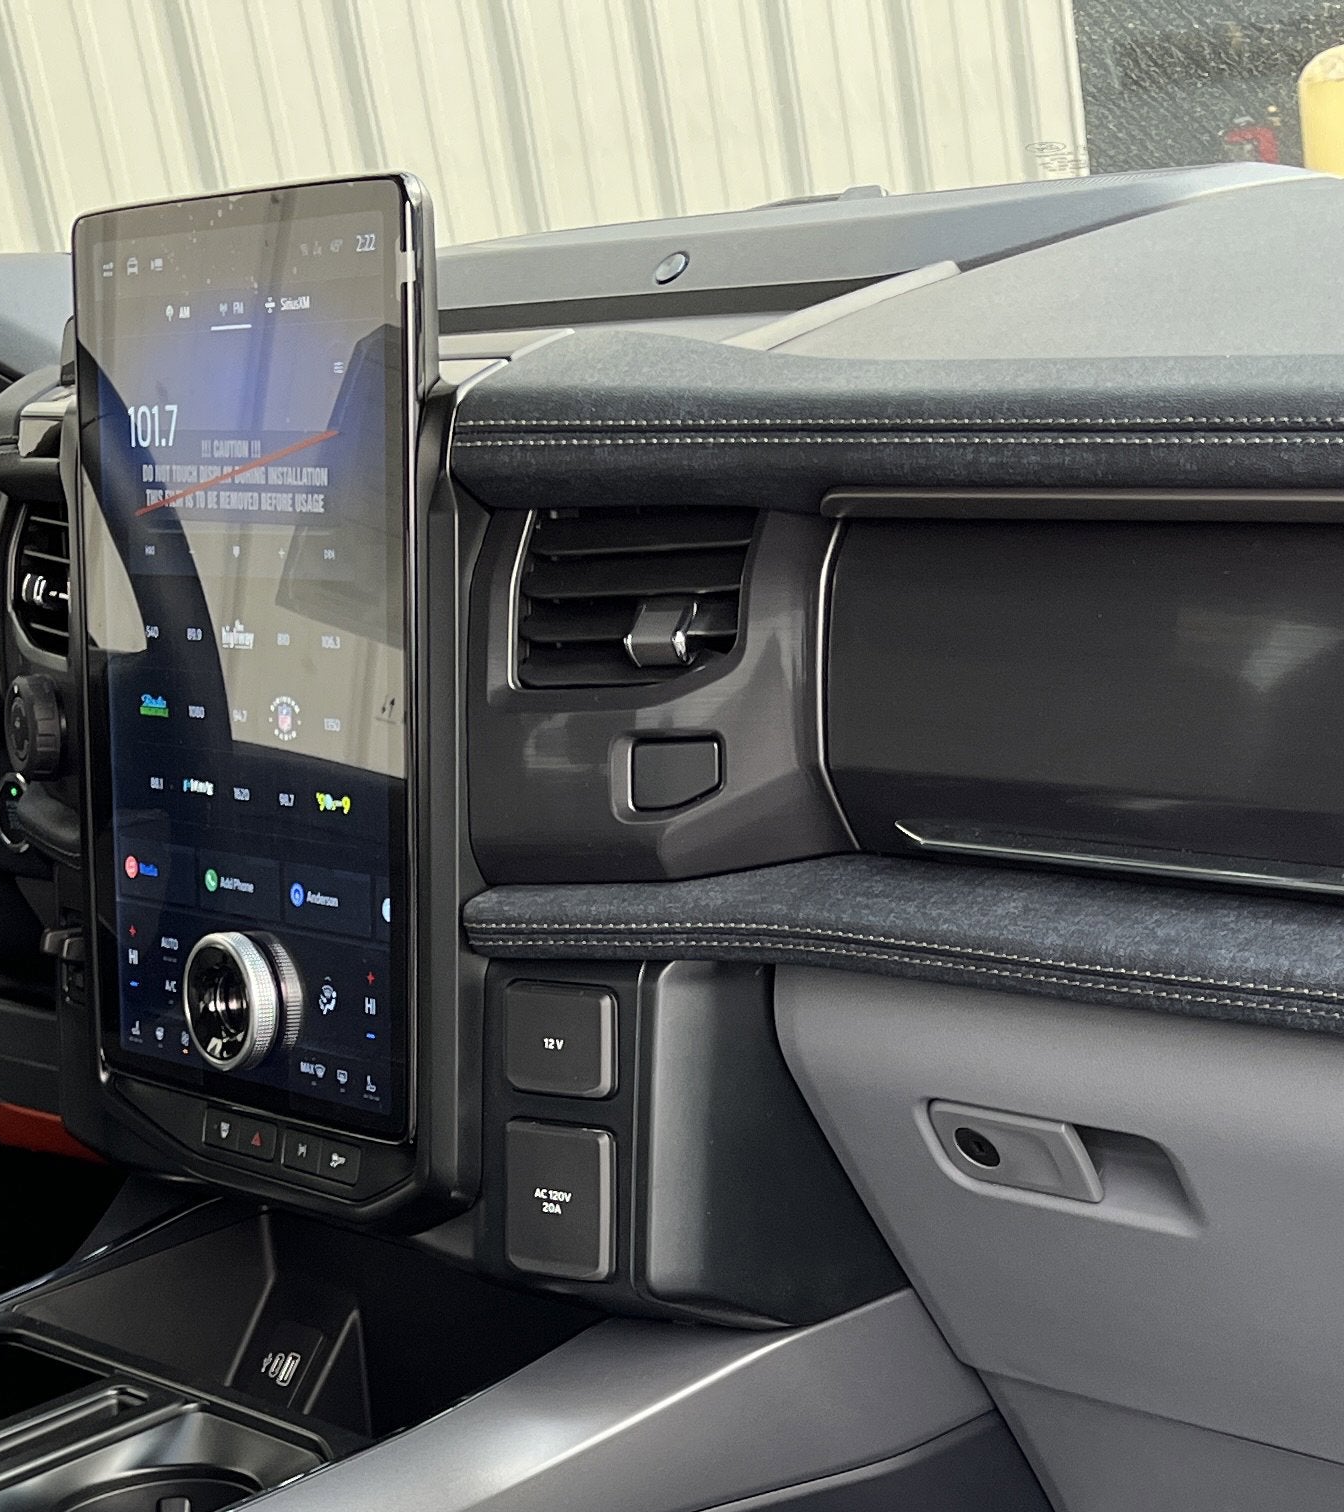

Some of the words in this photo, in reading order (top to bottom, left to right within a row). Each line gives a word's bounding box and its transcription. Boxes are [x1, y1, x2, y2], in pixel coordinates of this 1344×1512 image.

[178, 306, 190, 319] AM
[127, 404, 178, 448] 101.7
[213, 439, 249, 459] CAUTION
[142, 464, 154, 482] DO
[172, 464, 197, 484] TOUCH
[267, 466, 328, 487] INSTALLATION
[195, 491, 206, 509] TO
[219, 491, 259, 511] REMOVED
[260, 492, 293, 512] BEFORE
[294, 492, 325, 514] USAGE
[219, 875, 234, 890] Add
[234, 878, 255, 894] Phone
[306, 890, 339, 908] Anderson
[128, 948, 139, 965] HI
[364, 996, 376, 1016] HI
[534, 1187, 548, 1199] AC
[548, 1190, 572, 1203] 120V
[542, 1201, 562, 1215] 20A
